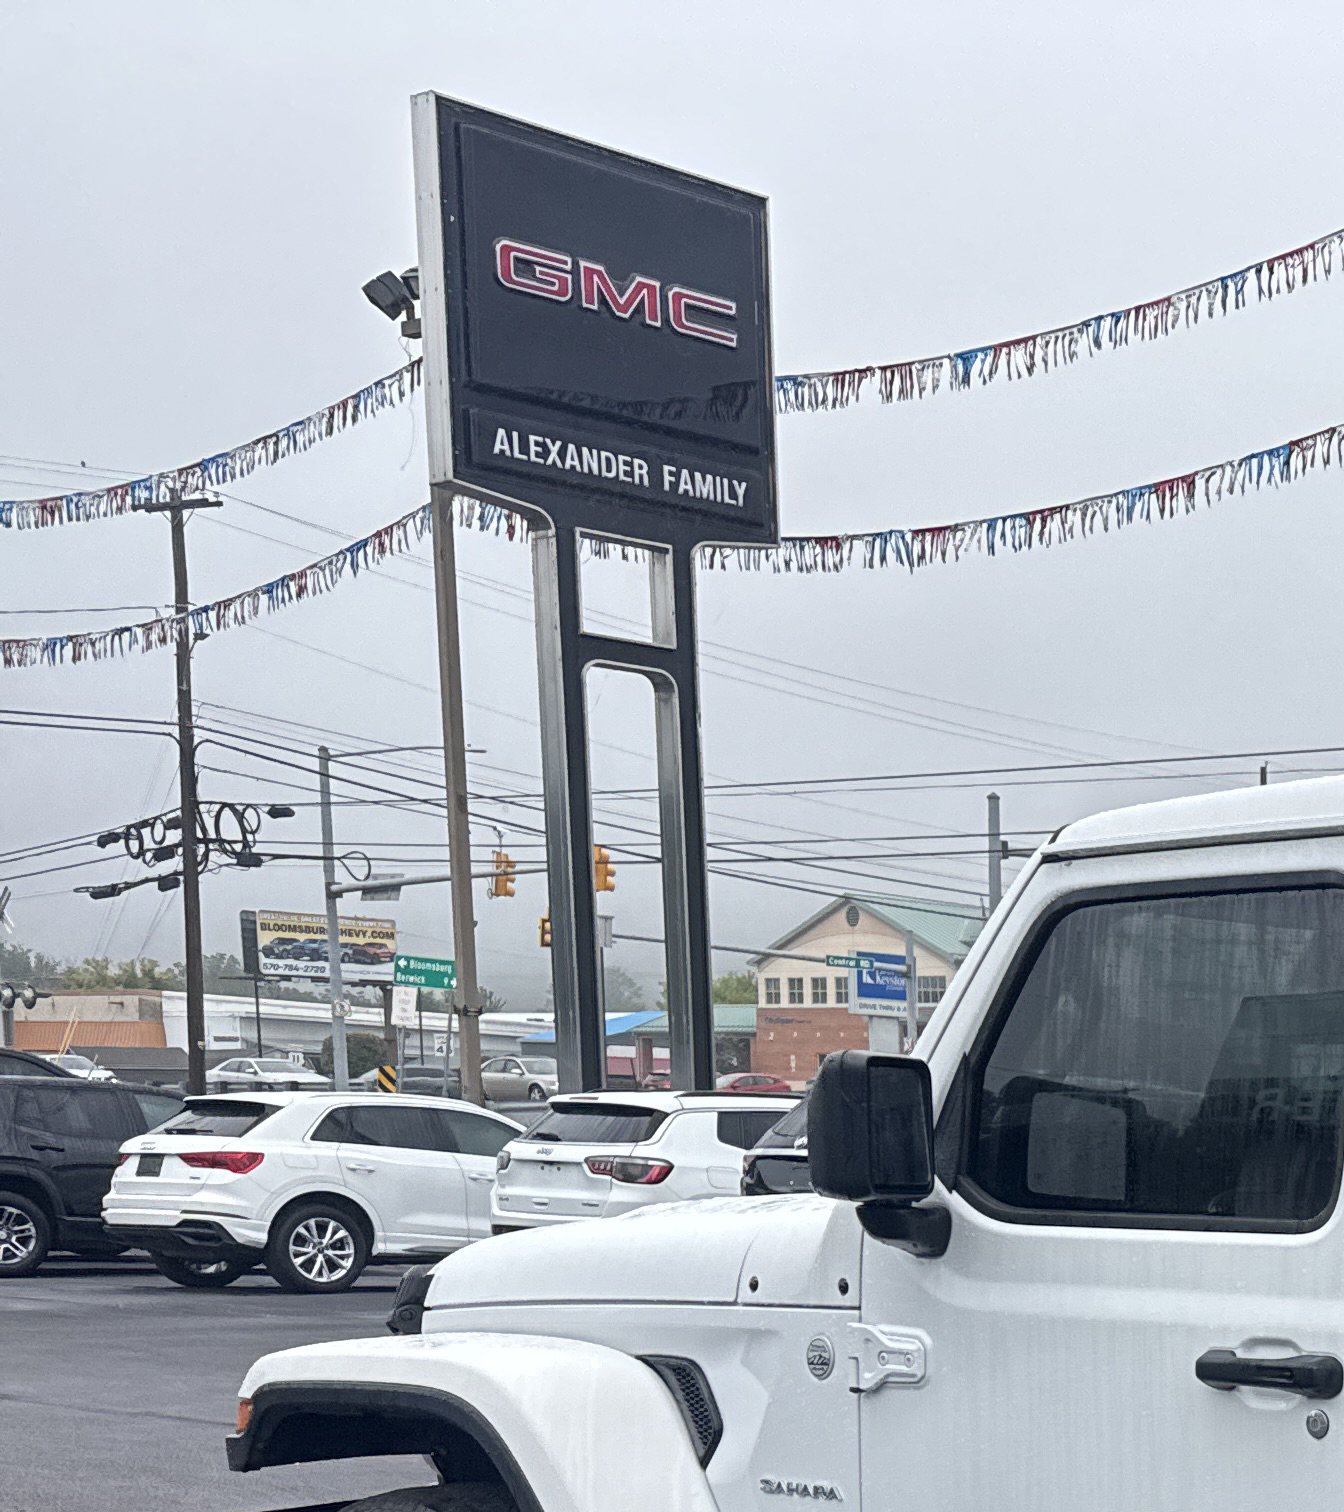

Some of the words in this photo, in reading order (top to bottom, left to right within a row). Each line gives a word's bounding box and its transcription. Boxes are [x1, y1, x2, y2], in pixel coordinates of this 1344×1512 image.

[494, 238, 738, 348] GMC
[493, 426, 650, 488] ALEXANDER
[662, 464, 748, 507] FAMILY
[260, 922, 395, 940] BLOOMSBURHEVY.COM
[396, 971, 426, 984] Berwick
[760, 1478, 844, 1503] SAHARA
